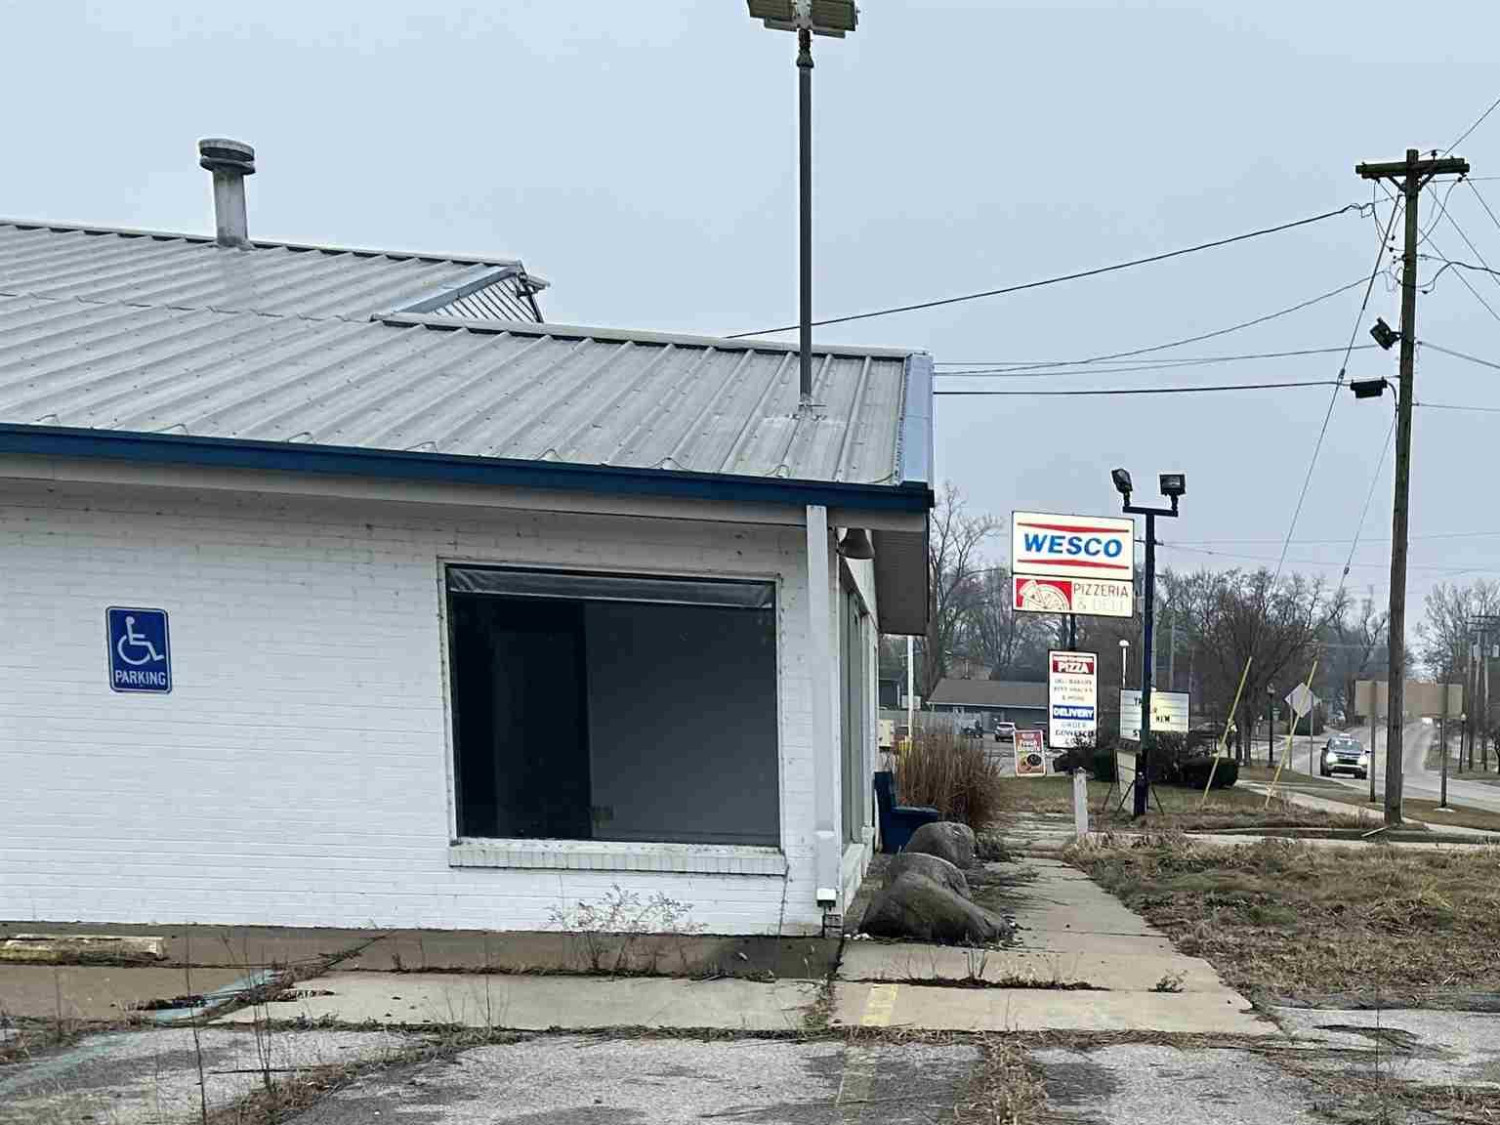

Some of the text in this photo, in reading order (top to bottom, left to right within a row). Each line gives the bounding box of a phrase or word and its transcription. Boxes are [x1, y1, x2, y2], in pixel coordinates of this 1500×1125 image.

[1024, 533, 1123, 558] WESCO
[1073, 582, 1130, 598] PIZZERIA
[1058, 661, 1090, 674] PIZZA
[115, 669, 166, 686] PARKING
[1053, 708, 1094, 719] DELIVERY
